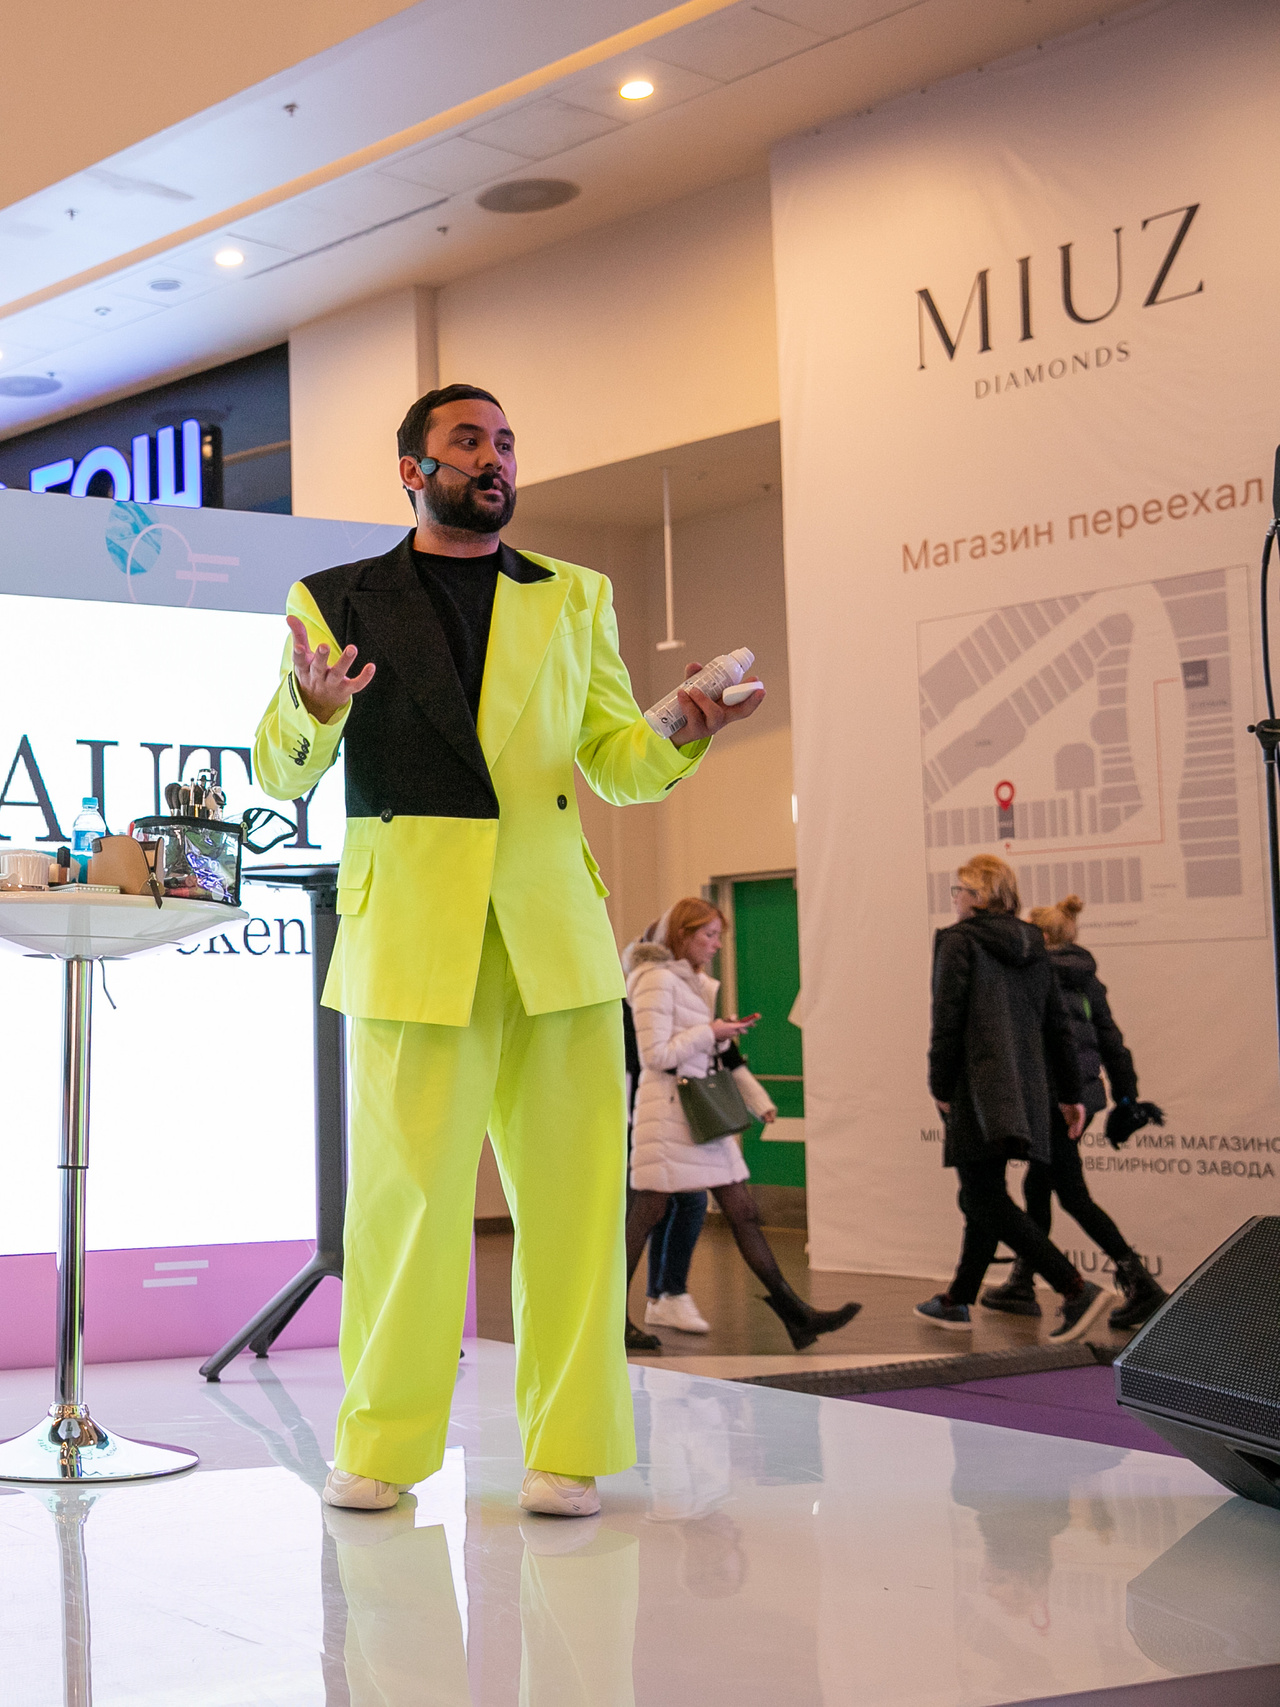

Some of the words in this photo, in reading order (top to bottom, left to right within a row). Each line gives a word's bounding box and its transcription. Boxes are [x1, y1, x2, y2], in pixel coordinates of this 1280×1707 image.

[915, 202, 1204, 371] MIUZ
[974, 339, 1131, 400] DIAMONDS
[901, 520, 1054, 574] Магазин
[1068, 477, 1264, 539] переехал
[1084, 1155, 1191, 1175] ВЕЛИРНОГО
[1196, 1159, 1275, 1179] ЗАВОДА
[1135, 1133, 1175, 1150] ИМЯ
